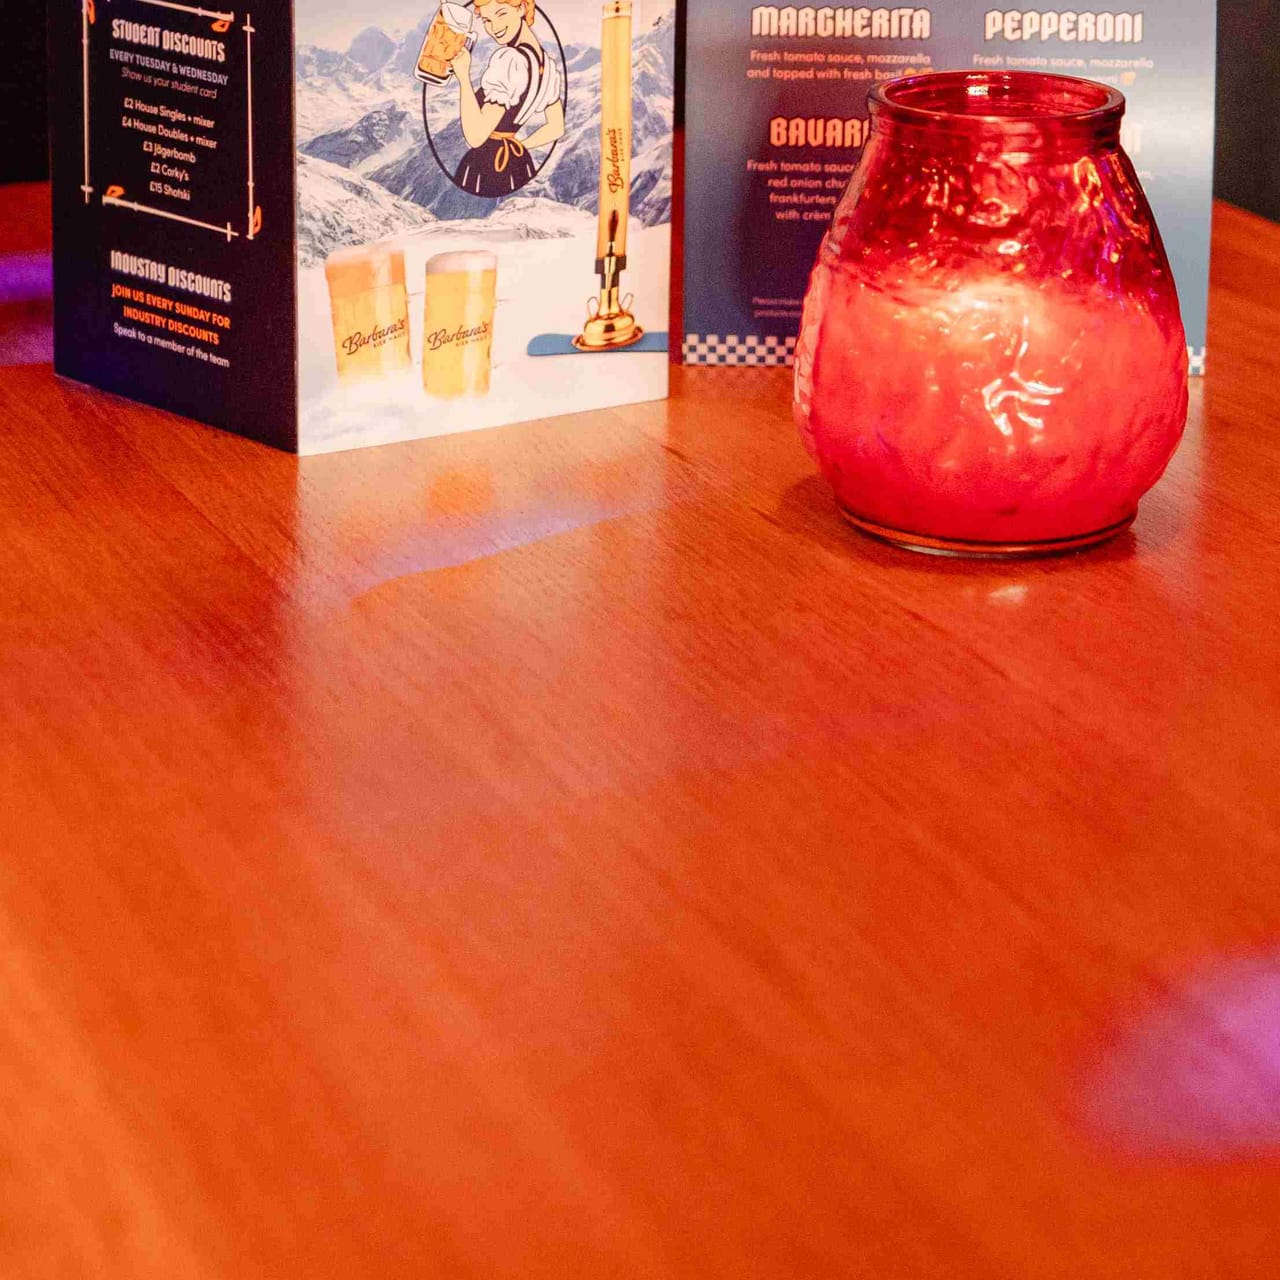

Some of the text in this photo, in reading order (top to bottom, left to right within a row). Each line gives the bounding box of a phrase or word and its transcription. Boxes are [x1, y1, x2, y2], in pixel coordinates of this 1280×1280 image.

[751, 5, 931, 39] MARGHERITA
[984, 9, 1143, 43] PEPPERONI
[112, 18, 225, 62] STUDENT DISCOUNTS
[109, 48, 228, 86] EVERY TUESDAY & WEDNESDAY
[750, 50, 931, 66] Fresh tomato sauce, mozzarella
[121, 67, 142, 81] Show
[143, 74, 152, 83] us
[153, 78, 170, 87] your
[171, 80, 198, 94] student
[747, 68, 770, 79] and
[772, 68, 814, 81] topped
[816, 68, 839, 80] with
[843, 68, 872, 81] fresh
[124, 97, 133, 109] £2
[135, 99, 158, 115] House
[159, 105, 186, 122] Singles
[193, 115, 215, 128] mixer
[122, 116, 132, 127] £4
[133, 118, 156, 134] House
[158, 124, 188, 142] Doubles
[195, 136, 217, 149] mixer
[143, 140, 153, 152] £3
[770, 117, 869, 148] BAVARI
[150, 162, 189, 182] £2 Corky's
[747, 159, 777, 171] Fresh
[780, 160, 821, 172] tomato
[149, 181, 191, 201] £15 Shotski
[767, 177, 788, 189] red
[790, 178, 822, 189] onion
[769, 192, 837, 206] frankfurters
[775, 210, 800, 220] with
[110, 250, 231, 303] INDUSTRY DISCOUNTS
[111, 283, 230, 329] JOIN US EVERY SUNDAY FOR
[123, 305, 219, 346] INDUSTRY DISCOUNTS
[342, 318, 405, 356] Barbara's
[427, 321, 489, 351] Barbara's
[113, 321, 230, 368] Speak to a member of the team
